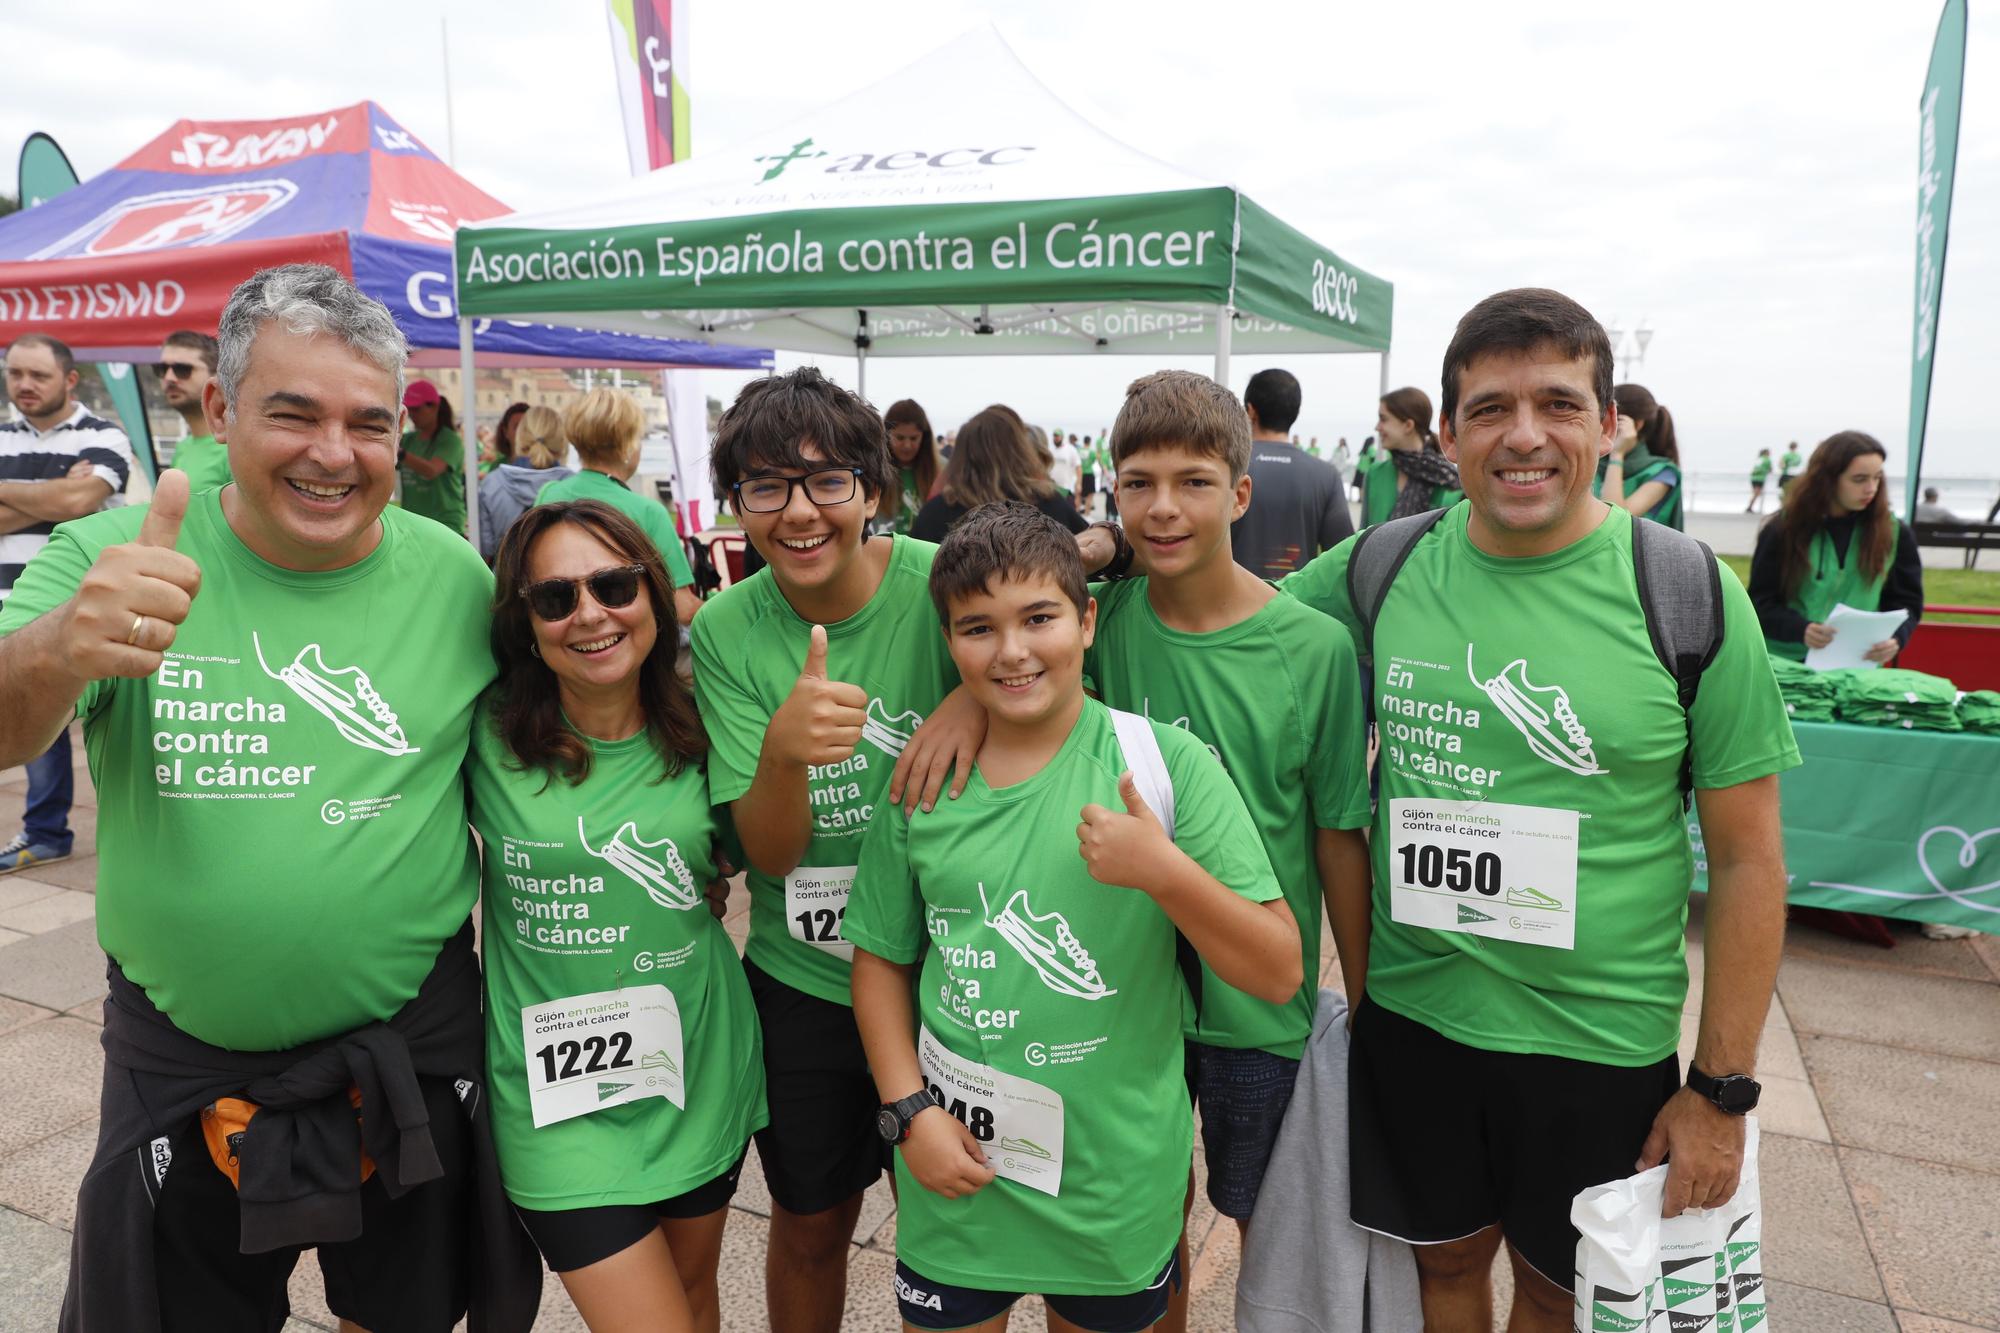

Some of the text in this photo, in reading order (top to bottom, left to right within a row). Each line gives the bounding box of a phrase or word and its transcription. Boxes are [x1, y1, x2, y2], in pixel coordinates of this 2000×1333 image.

[824, 146, 1037, 173] aecc
[466, 219, 1215, 286] Asociación Española contra el Cáncer
[1312, 259, 1357, 324] aecc
[158, 660, 203, 689] En
[1386, 663, 1413, 689] En
[154, 697, 286, 723] marcha
[1382, 694, 1480, 728] marcha
[153, 729, 268, 754] contra
[1386, 720, 1462, 753] contra
[154, 759, 316, 786] el cáncer
[808, 753, 869, 781] archa
[1409, 751, 1502, 787] cáncer
[808, 782, 861, 806] ntra
[818, 804, 873, 828] cánc
[1402, 808, 1500, 826] Gijón en marcha
[1402, 821, 1501, 839] contra el cáncer
[503, 842, 531, 870] En
[1398, 842, 1502, 896] 1050
[505, 873, 604, 895] marcha
[795, 879, 821, 890] Gijón
[823, 880, 837, 888] en
[795, 890, 829, 899] contra
[832, 888, 842, 897] el
[512, 896, 589, 920] contra
[516, 918, 630, 945] el cáncer
[534, 1012, 565, 1023] Gijón
[568, 1008, 582, 1018] en
[585, 1000, 629, 1015] marcha
[535, 1021, 574, 1034] contra
[576, 1017, 588, 1027] el
[591, 1011, 630, 1025] cáncer
[535, 1031, 634, 1083] 1222
[923, 1053, 995, 1099] contra el cáncer
[940, 1059, 952, 1071] en
[953, 1065, 994, 1088] marcha
[922, 1075, 994, 1142] 048
